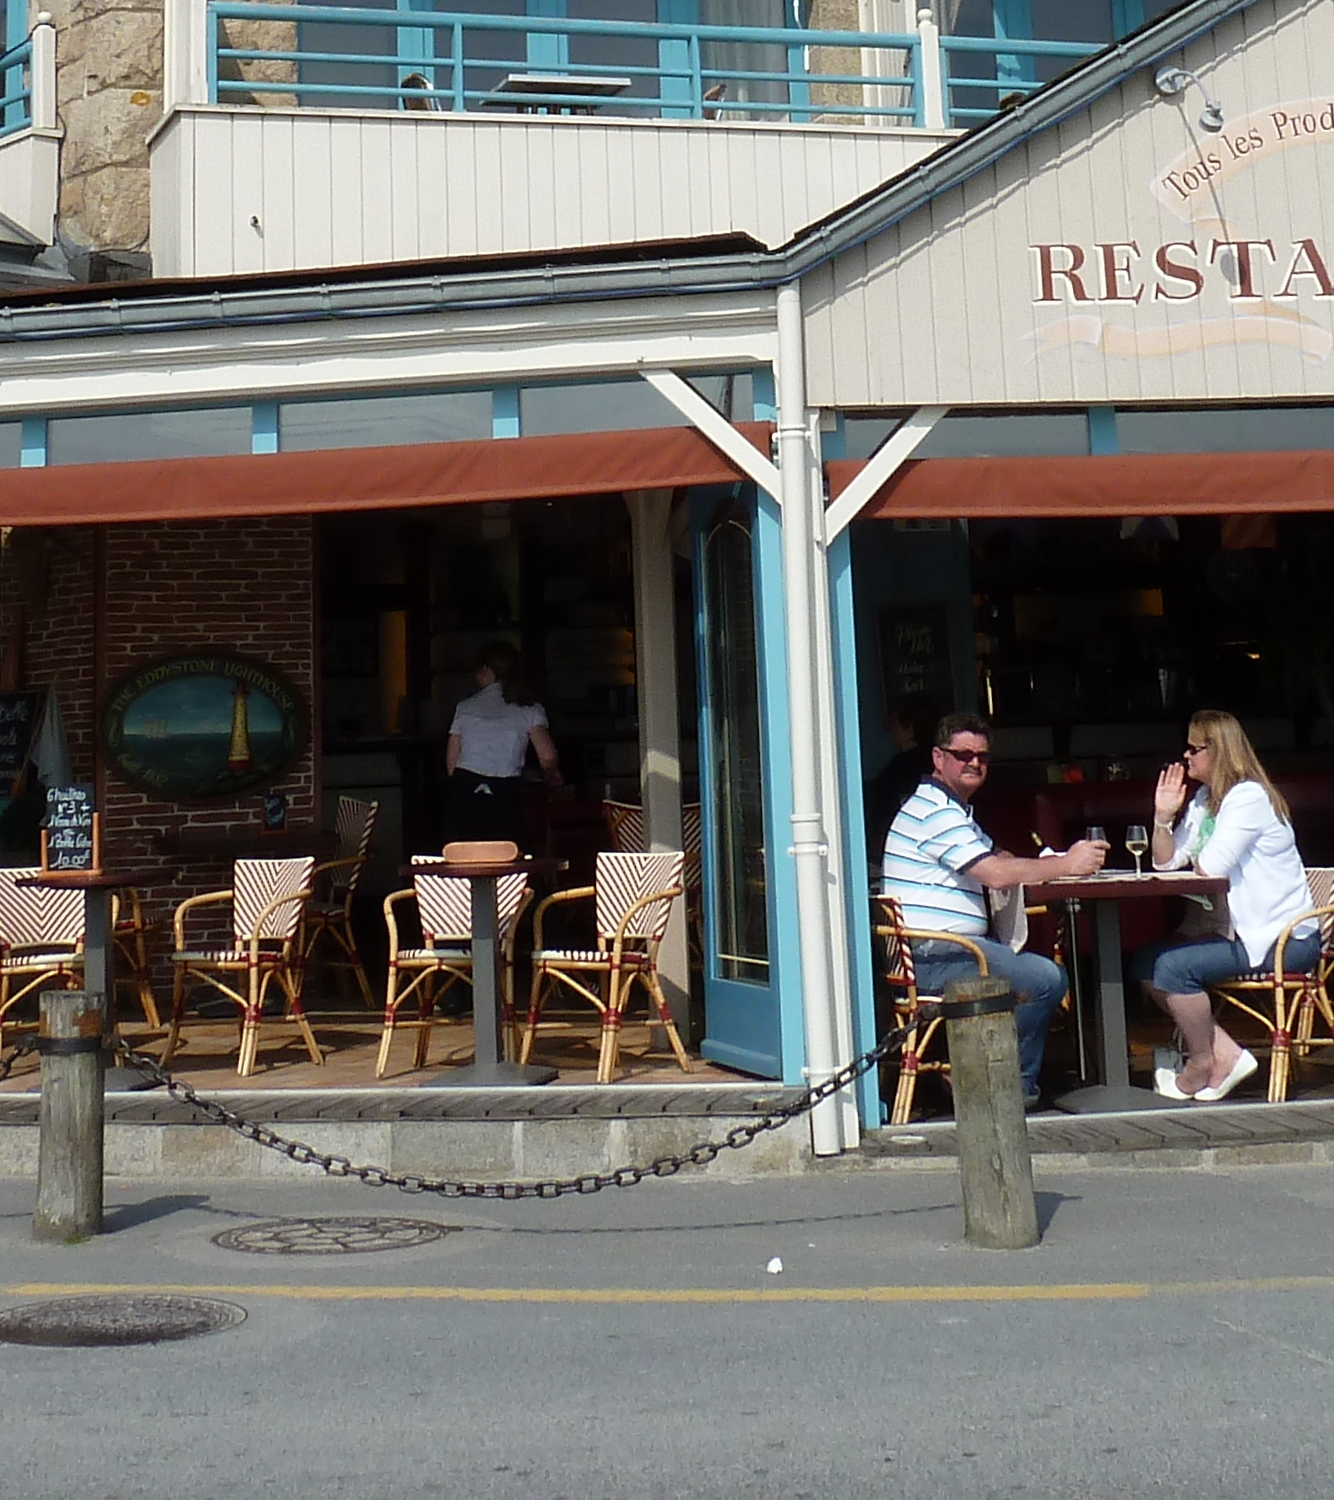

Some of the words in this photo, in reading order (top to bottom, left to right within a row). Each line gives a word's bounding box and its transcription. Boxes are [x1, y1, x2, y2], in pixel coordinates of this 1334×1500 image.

[1162, 149, 1223, 201] Tous
[1222, 126, 1264, 160] les
[136, 660, 216, 689] EDDYSTONE
